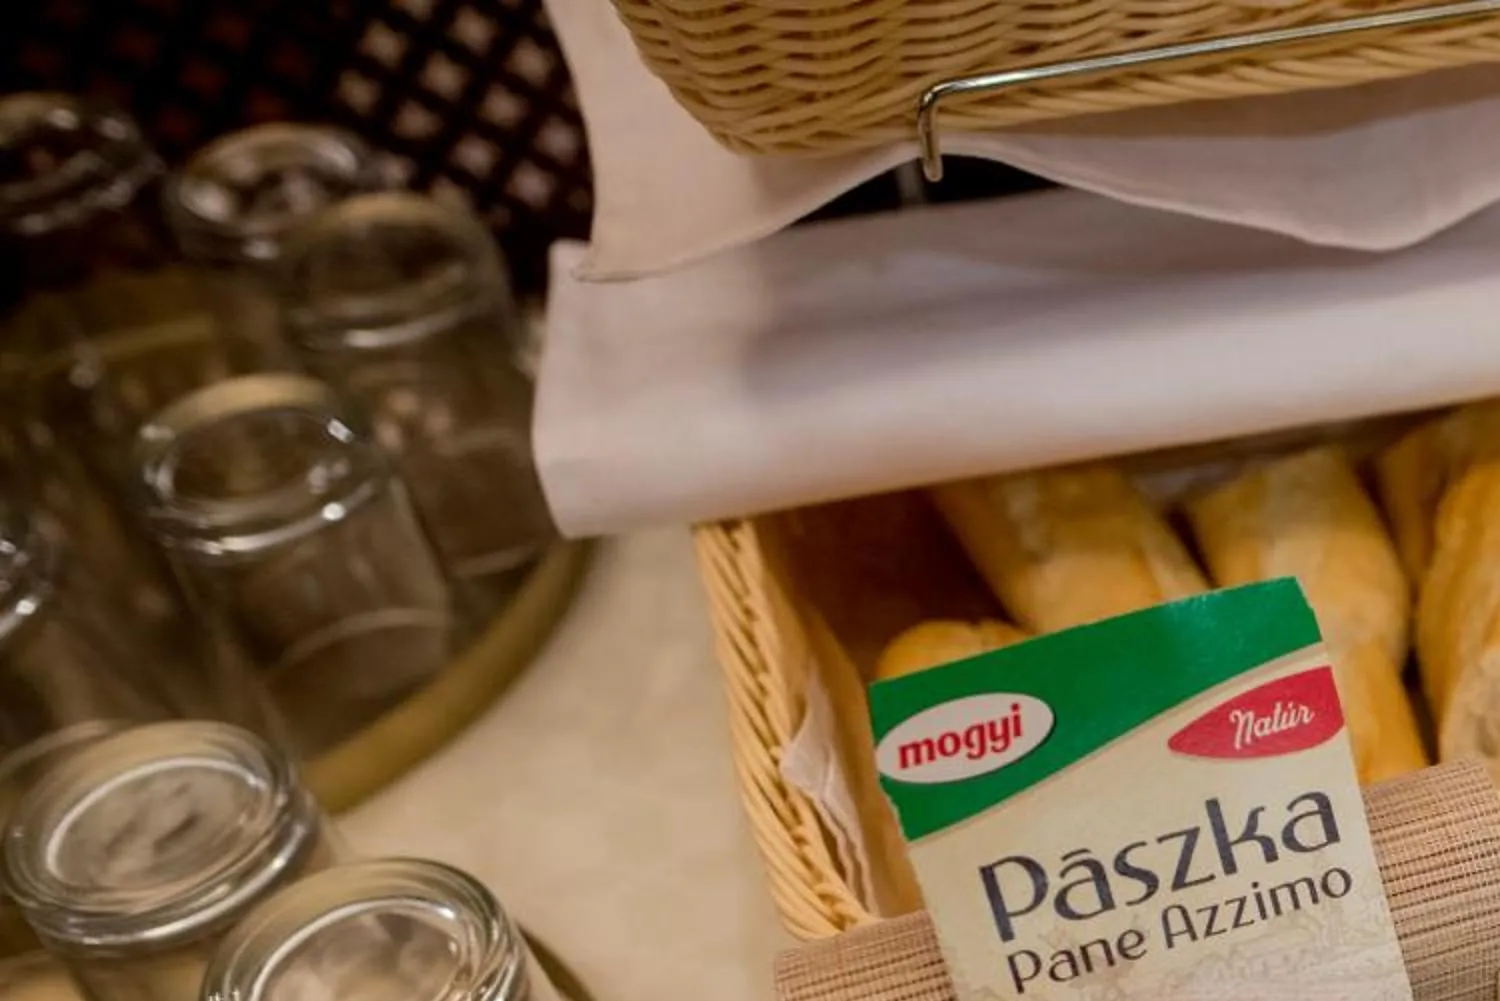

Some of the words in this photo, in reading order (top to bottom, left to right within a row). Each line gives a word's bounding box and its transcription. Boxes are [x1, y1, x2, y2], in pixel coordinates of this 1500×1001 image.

[898, 702, 1022, 769] mogyi
[1007, 928, 1148, 994] Pane
[1161, 867, 1353, 950] Azzimo
